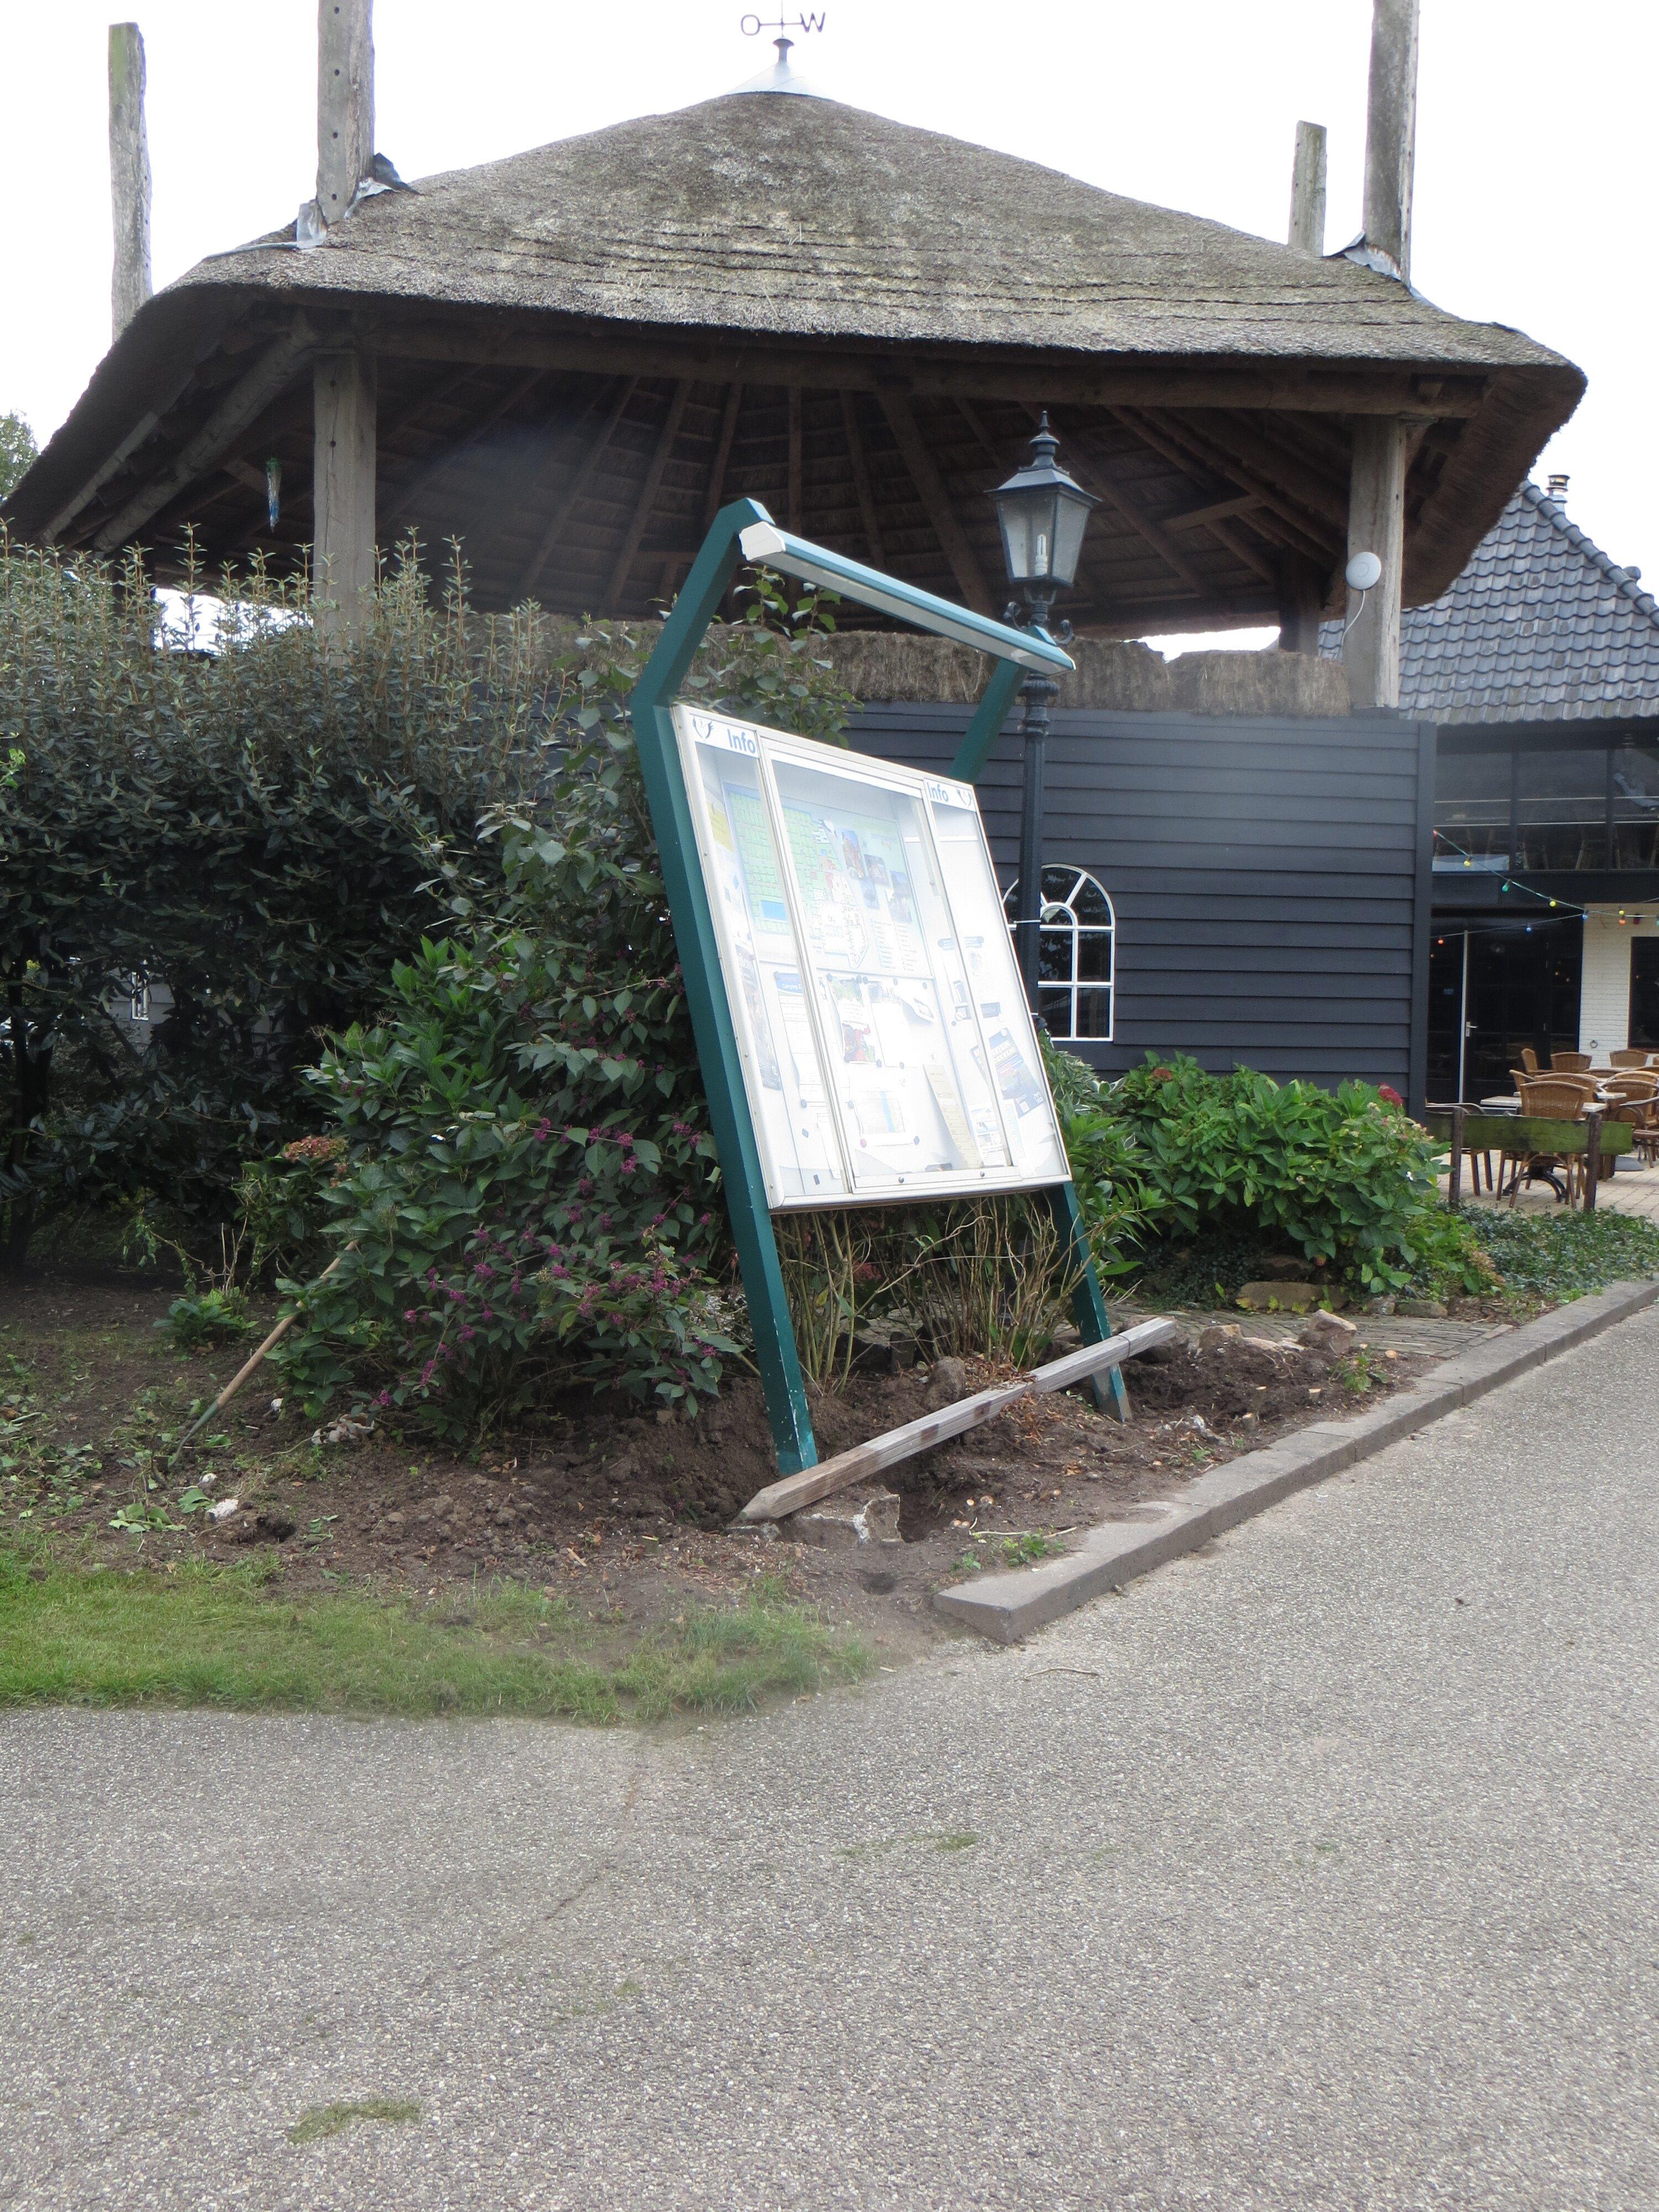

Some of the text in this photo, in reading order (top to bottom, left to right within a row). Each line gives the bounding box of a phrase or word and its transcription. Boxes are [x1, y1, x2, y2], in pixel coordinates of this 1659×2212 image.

[740, 12, 826, 36] O W
[727, 728, 755, 754] Info
[926, 781, 948, 802] Info
